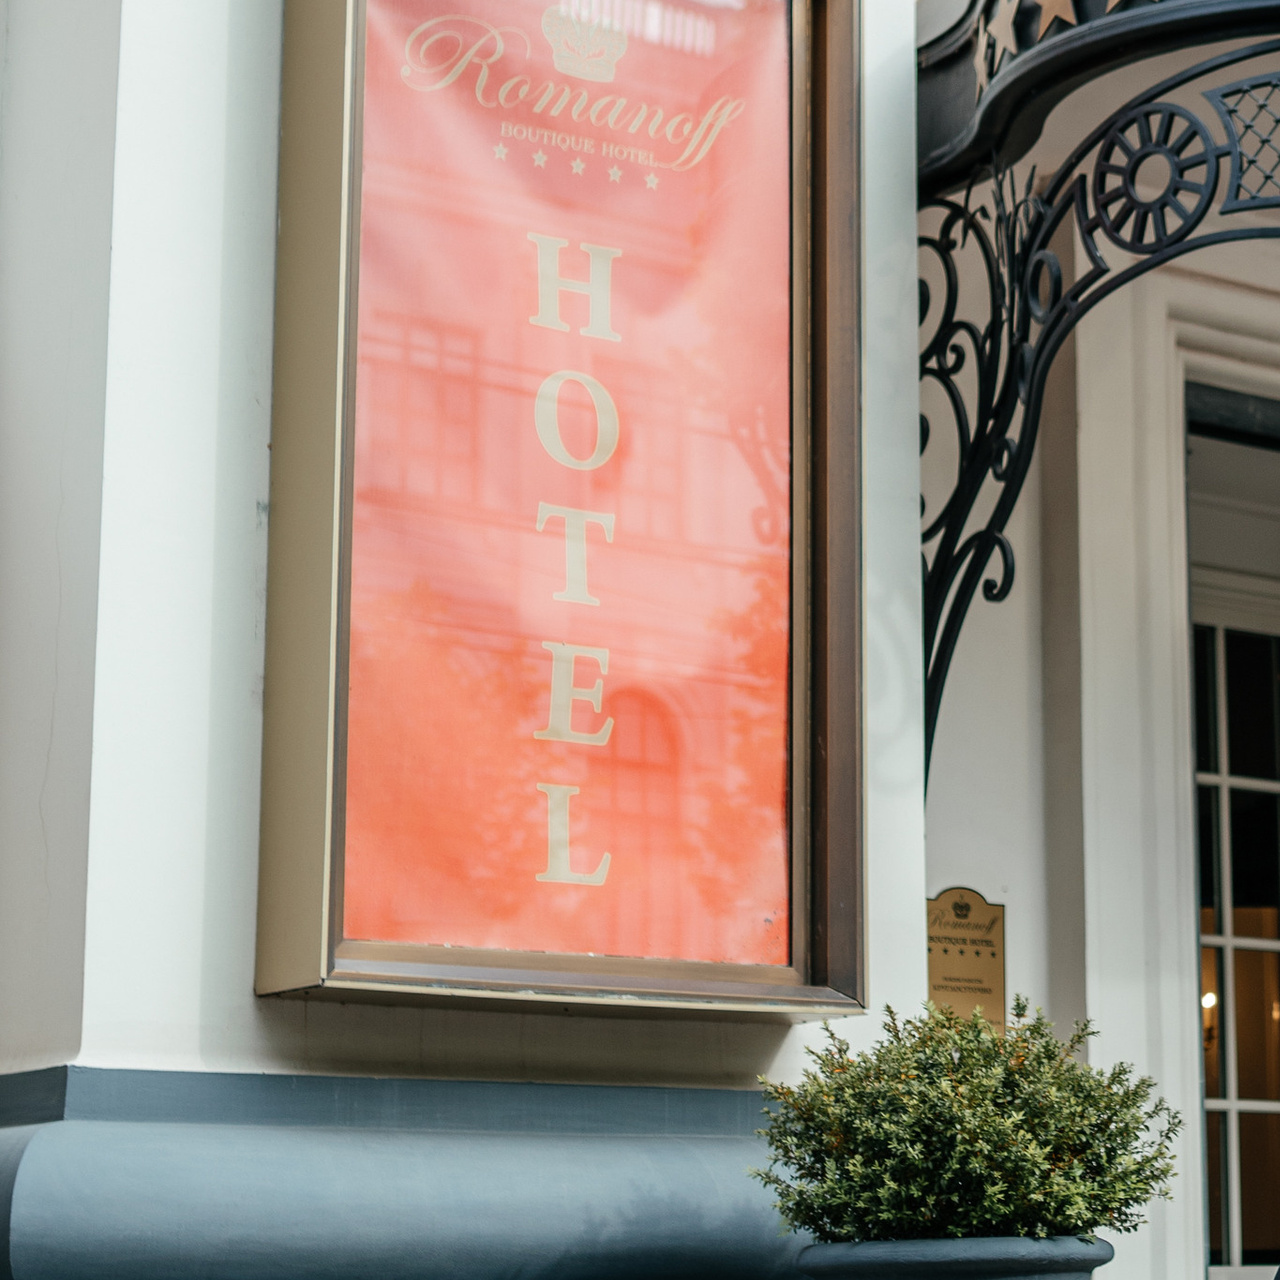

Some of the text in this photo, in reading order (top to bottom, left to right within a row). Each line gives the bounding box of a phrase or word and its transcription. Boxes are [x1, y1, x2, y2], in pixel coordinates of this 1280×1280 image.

[400, 14, 746, 172] Romanoff
[500, 121, 659, 169] BOUTIQUE HOTEL
[525, 231, 623, 886] HOTEL
